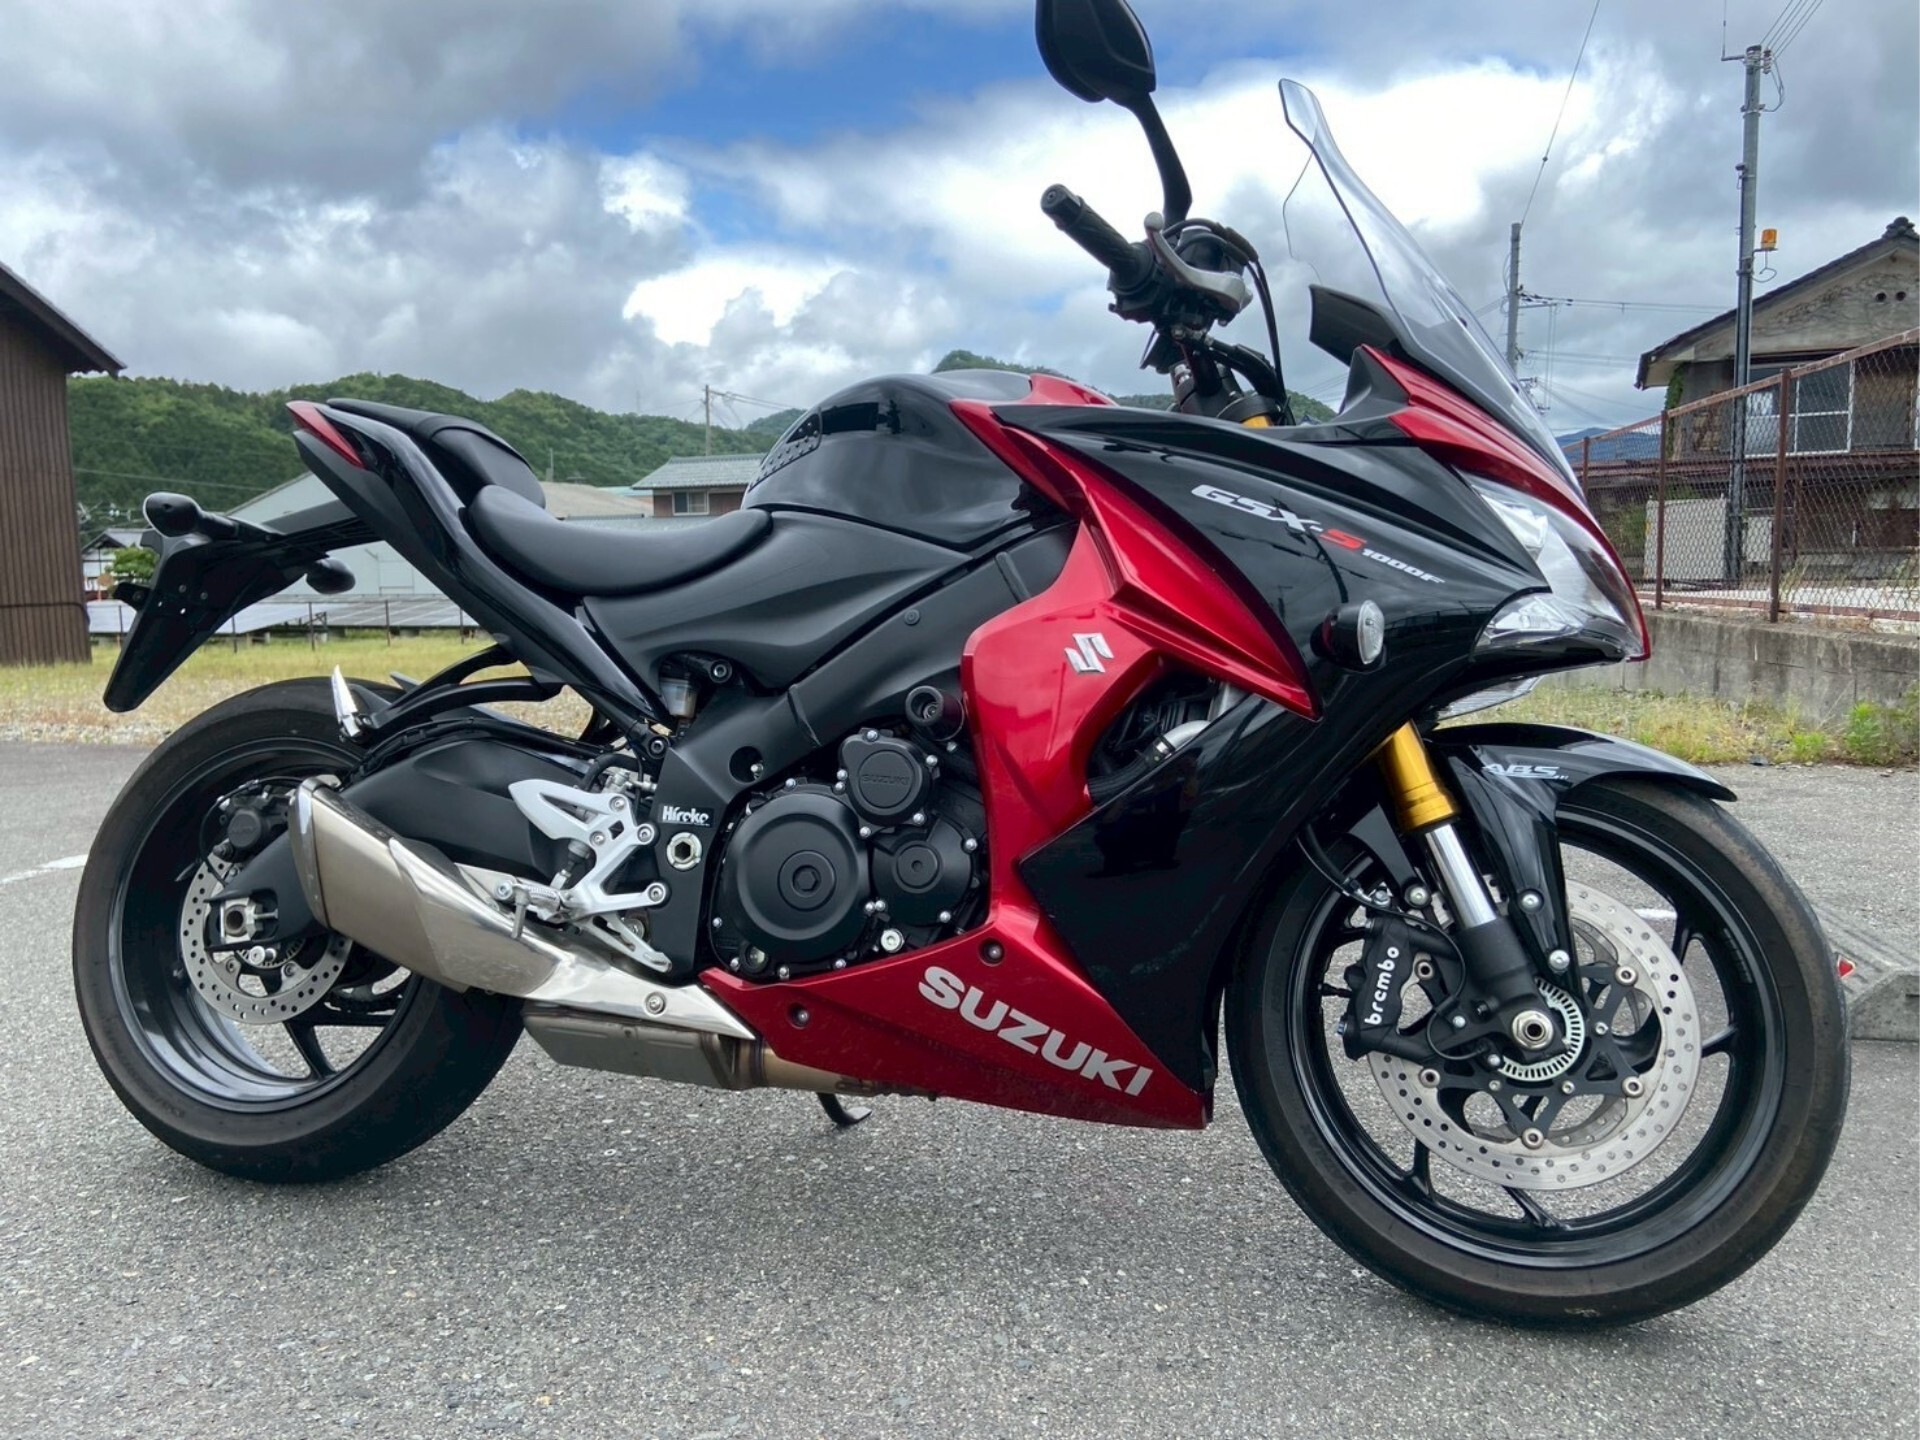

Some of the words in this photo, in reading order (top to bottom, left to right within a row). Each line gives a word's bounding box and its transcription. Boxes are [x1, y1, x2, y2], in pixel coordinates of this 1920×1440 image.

[1191, 484, 1367, 550] GSX-S
[1361, 548, 1446, 584] 1000F
[861, 774, 911, 786] SUZUKI
[1482, 763, 1559, 778] ABS
[1364, 946, 1400, 1025] brembo
[918, 966, 1153, 1097] SUZUKI
